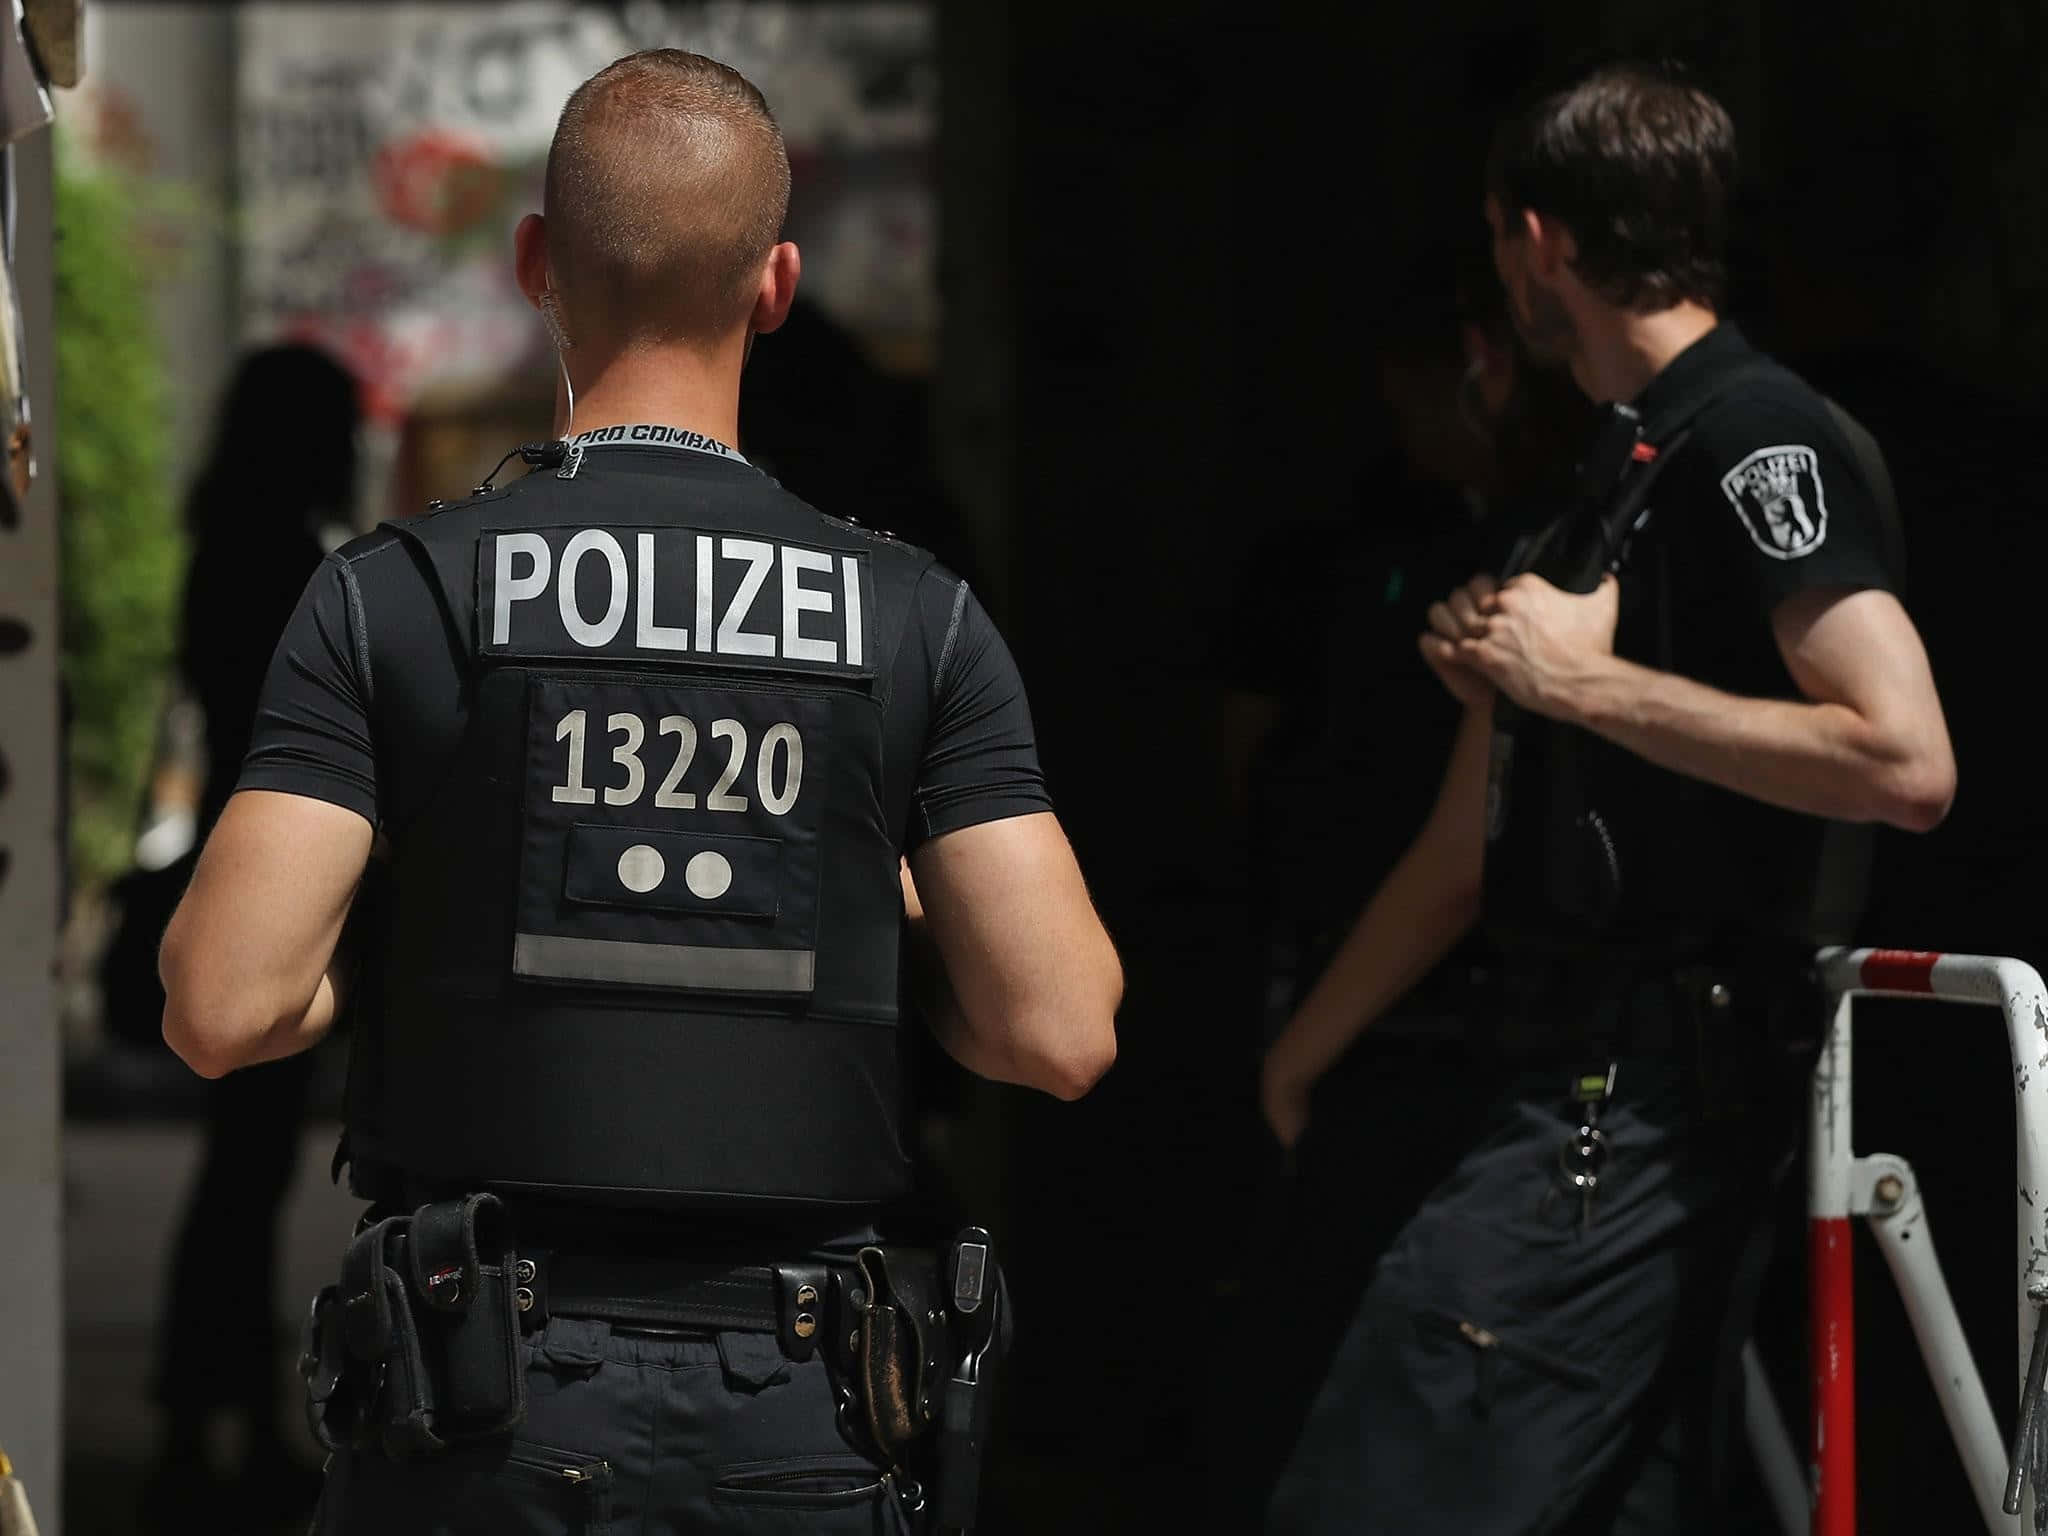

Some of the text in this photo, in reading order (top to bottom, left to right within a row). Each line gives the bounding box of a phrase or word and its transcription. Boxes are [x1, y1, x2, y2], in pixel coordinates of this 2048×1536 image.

[573, 425, 731, 455] PRO COMBAT
[1731, 454, 1808, 496] POLIZEI
[493, 529, 862, 666] POLIZEI
[552, 709, 803, 815] 13220
